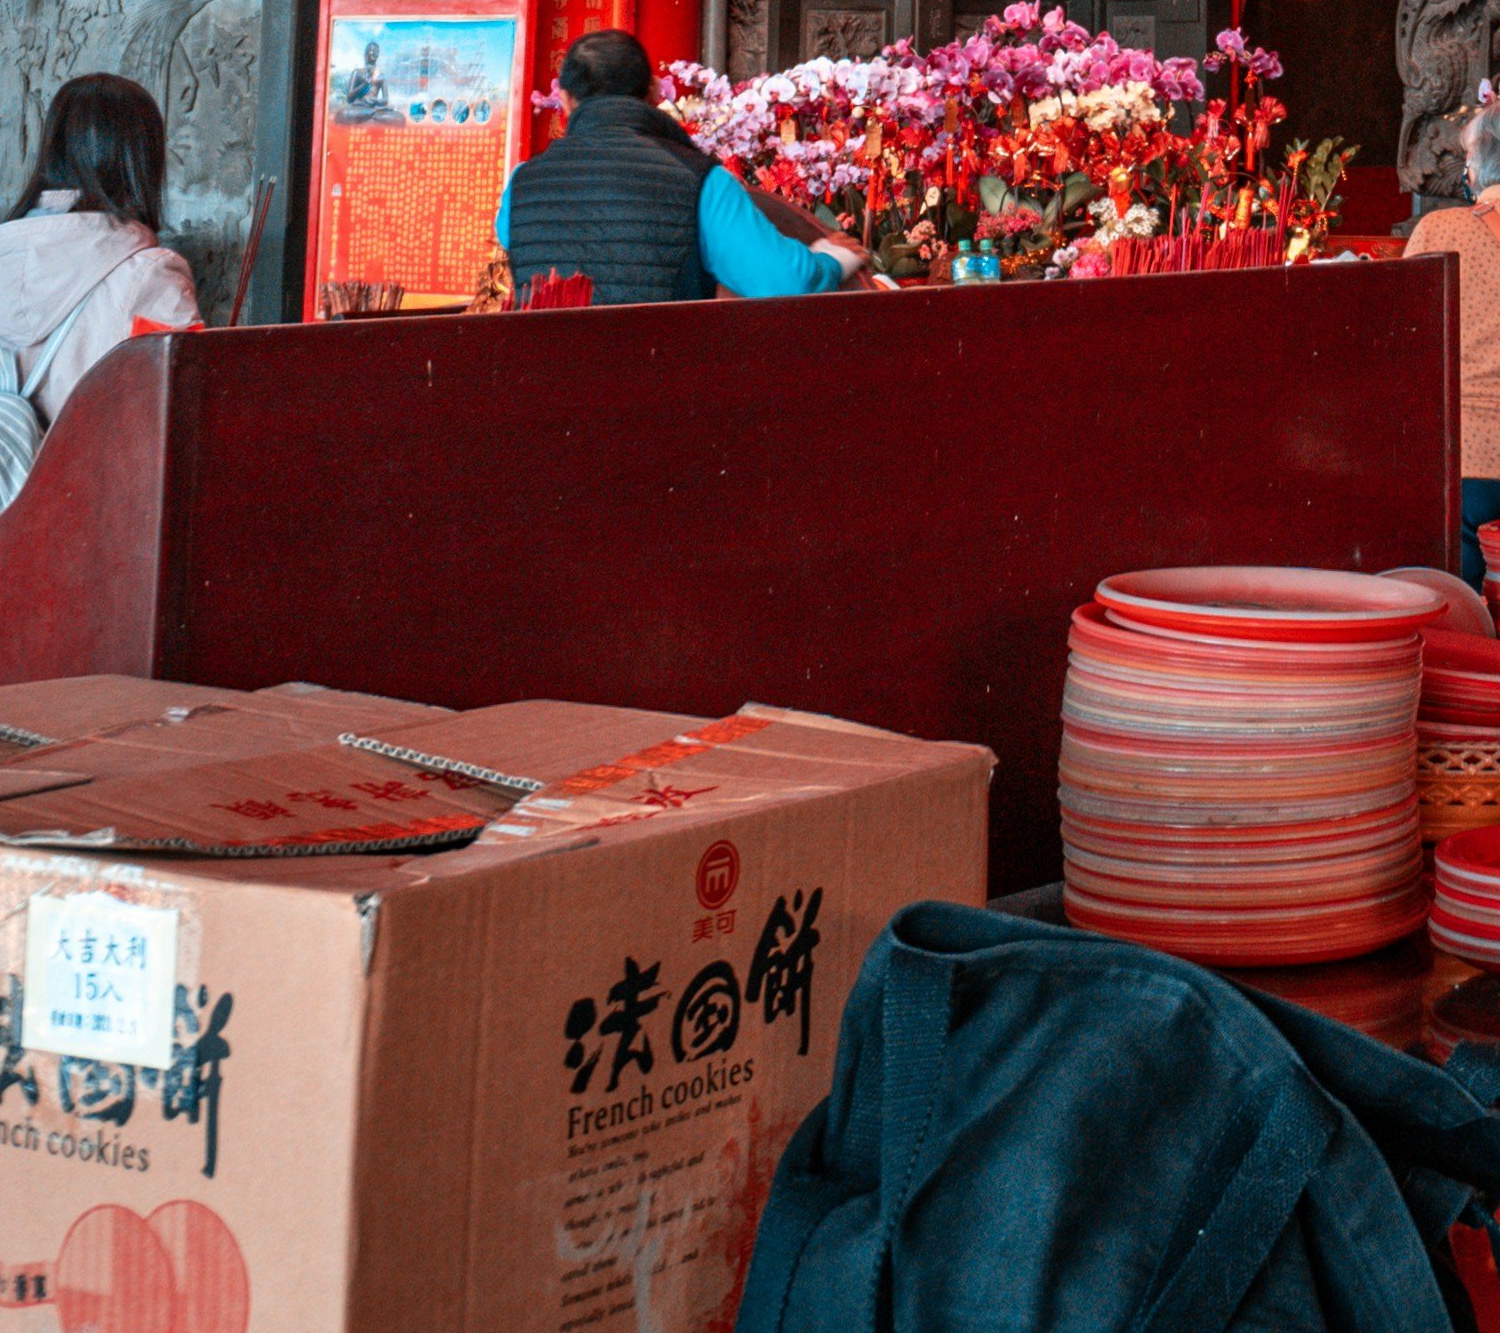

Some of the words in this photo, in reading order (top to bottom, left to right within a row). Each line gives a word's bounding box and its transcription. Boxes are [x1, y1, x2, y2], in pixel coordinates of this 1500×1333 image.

[51, 930, 147, 970] 大吉大利
[563, 887, 823, 1095] 法國餅
[567, 1087, 653, 1140] French
[661, 1057, 754, 1109] cookies
[45, 1130, 150, 1174] cookies
